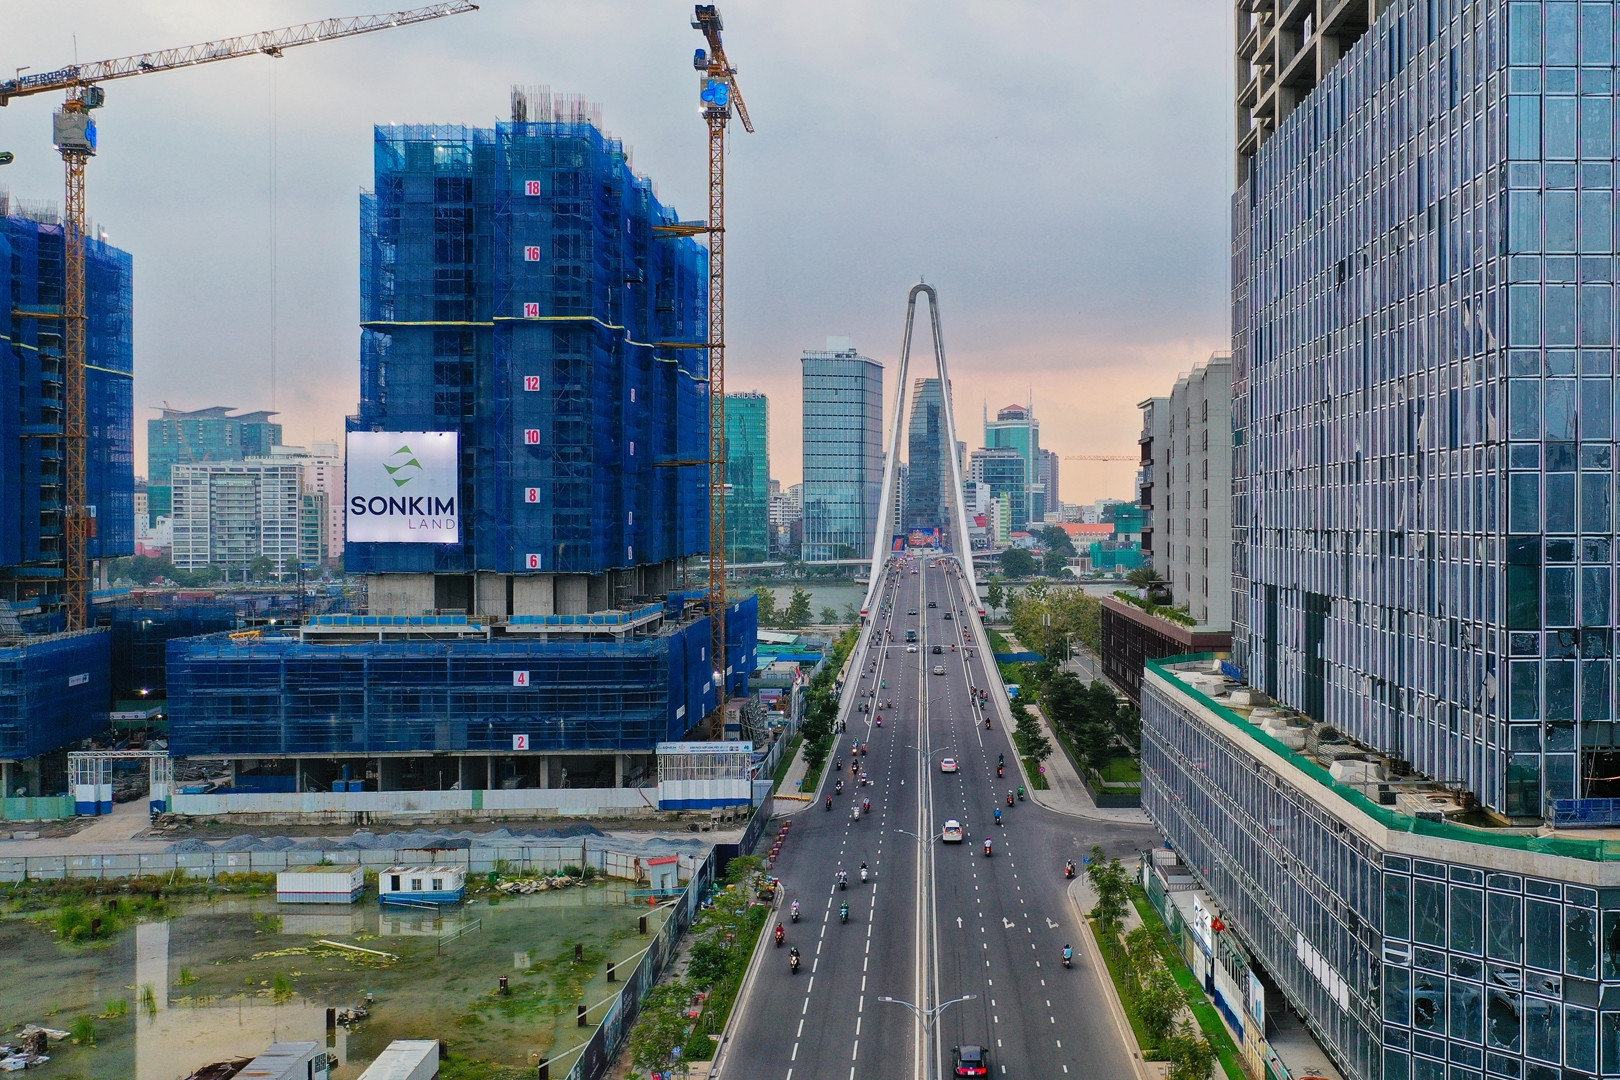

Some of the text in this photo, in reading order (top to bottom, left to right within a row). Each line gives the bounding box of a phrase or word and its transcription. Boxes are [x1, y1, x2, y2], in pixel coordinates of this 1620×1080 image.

[527, 182, 540, 195] 18
[527, 247, 540, 260] 16
[525, 304, 538, 317] 14
[526, 377, 539, 390] 12
[526, 430, 539, 443] 10
[529, 489, 537, 502] 8
[351, 496, 454, 516] SONKIM
[408, 518, 456, 530] LAND
[529, 554, 538, 568] 6
[518, 672, 525, 685] 4
[518, 736, 525, 749] 2
